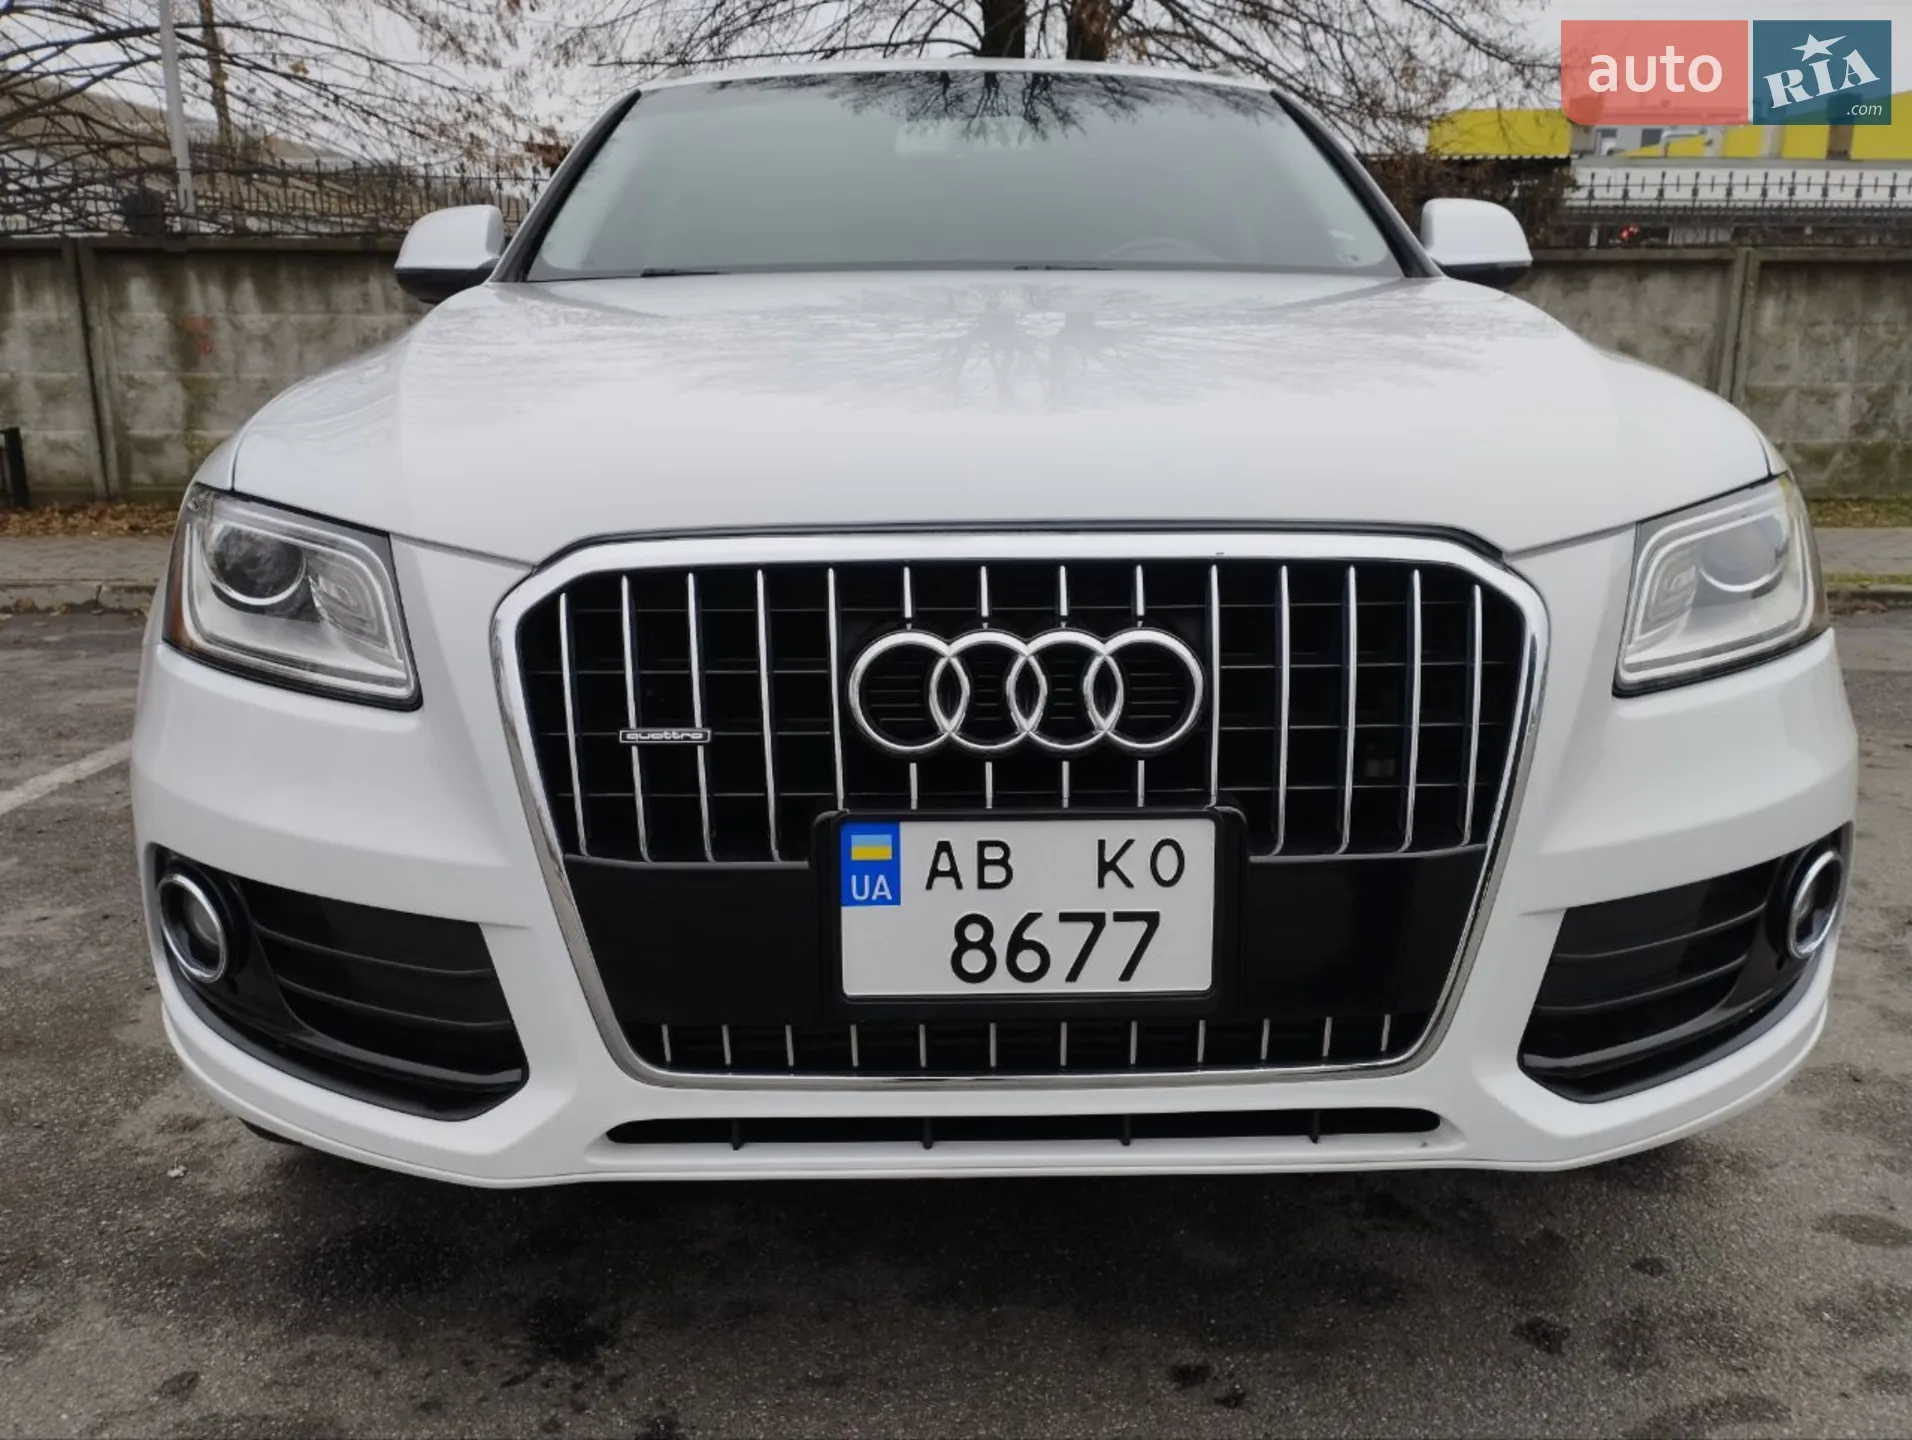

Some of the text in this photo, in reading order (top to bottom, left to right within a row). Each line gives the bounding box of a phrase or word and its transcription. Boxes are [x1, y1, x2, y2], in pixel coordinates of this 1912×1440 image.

[626, 730, 703, 742] quattro
[925, 839, 1014, 891] AB
[850, 874, 893, 901] UA
[950, 910, 1161, 985] 8677
